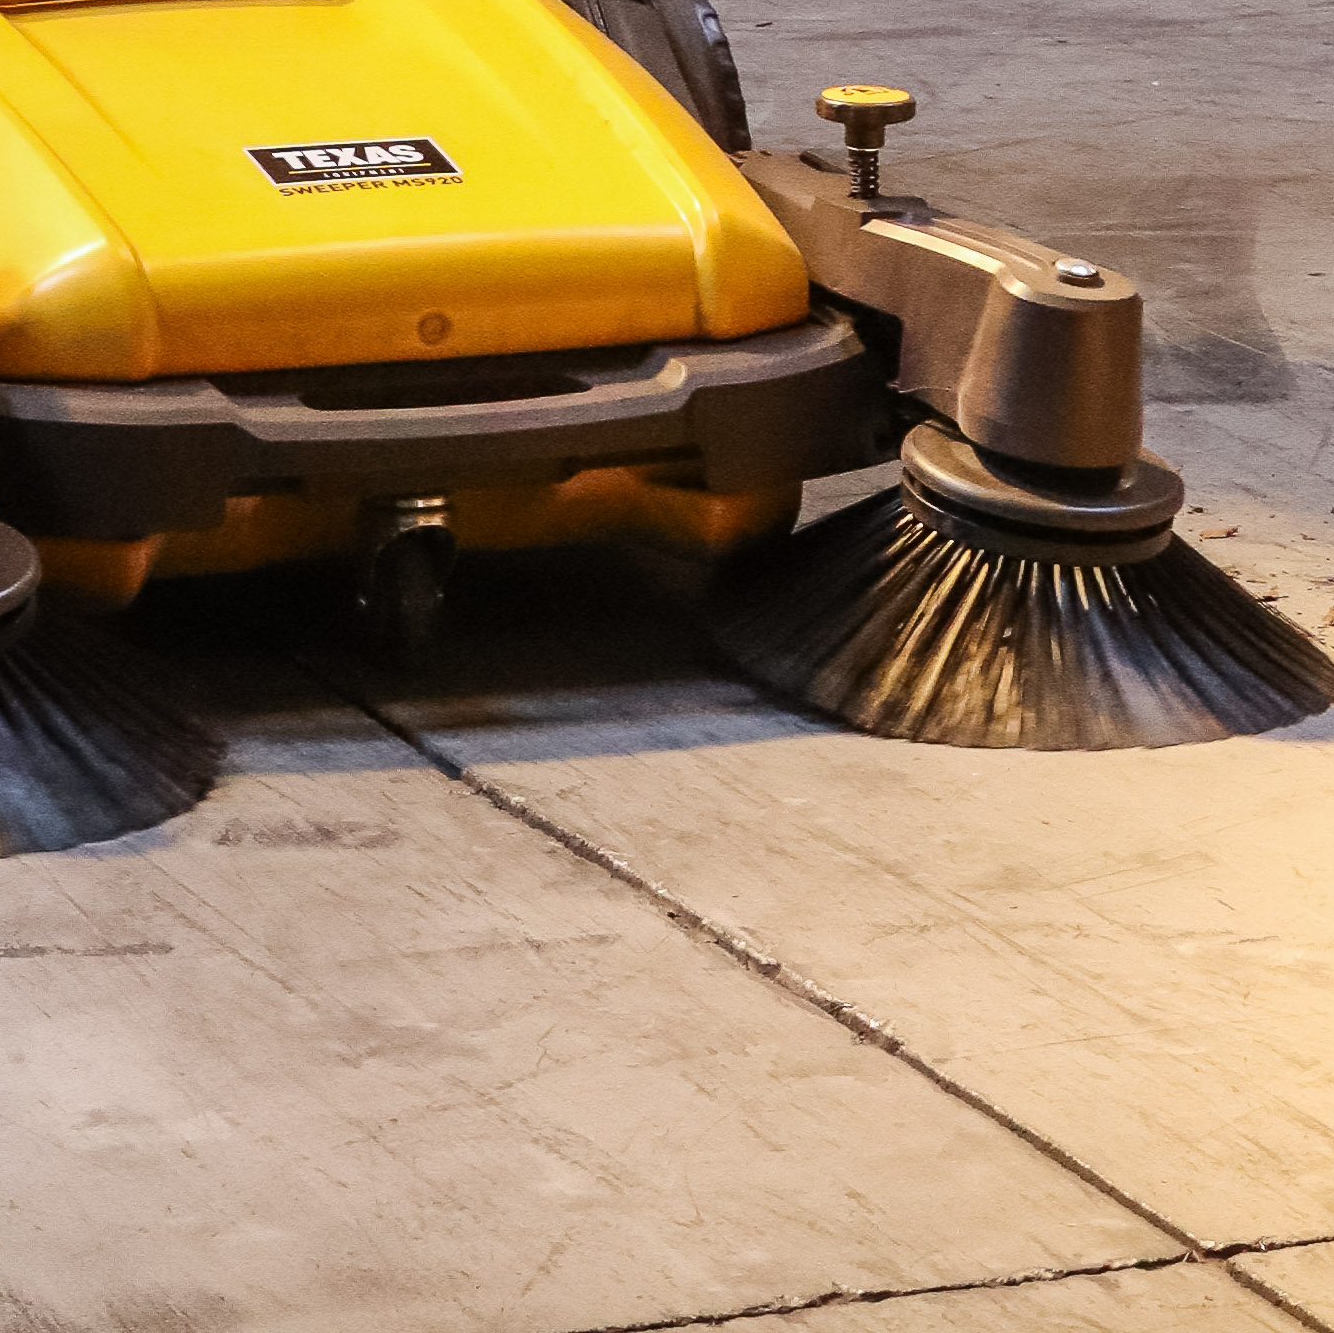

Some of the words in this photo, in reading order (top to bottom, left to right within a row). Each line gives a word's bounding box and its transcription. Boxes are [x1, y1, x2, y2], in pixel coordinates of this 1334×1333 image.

[273, 144, 424, 170] TEXAS
[279, 181, 388, 197] SWEEPER
[393, 175, 464, 188] MS920
